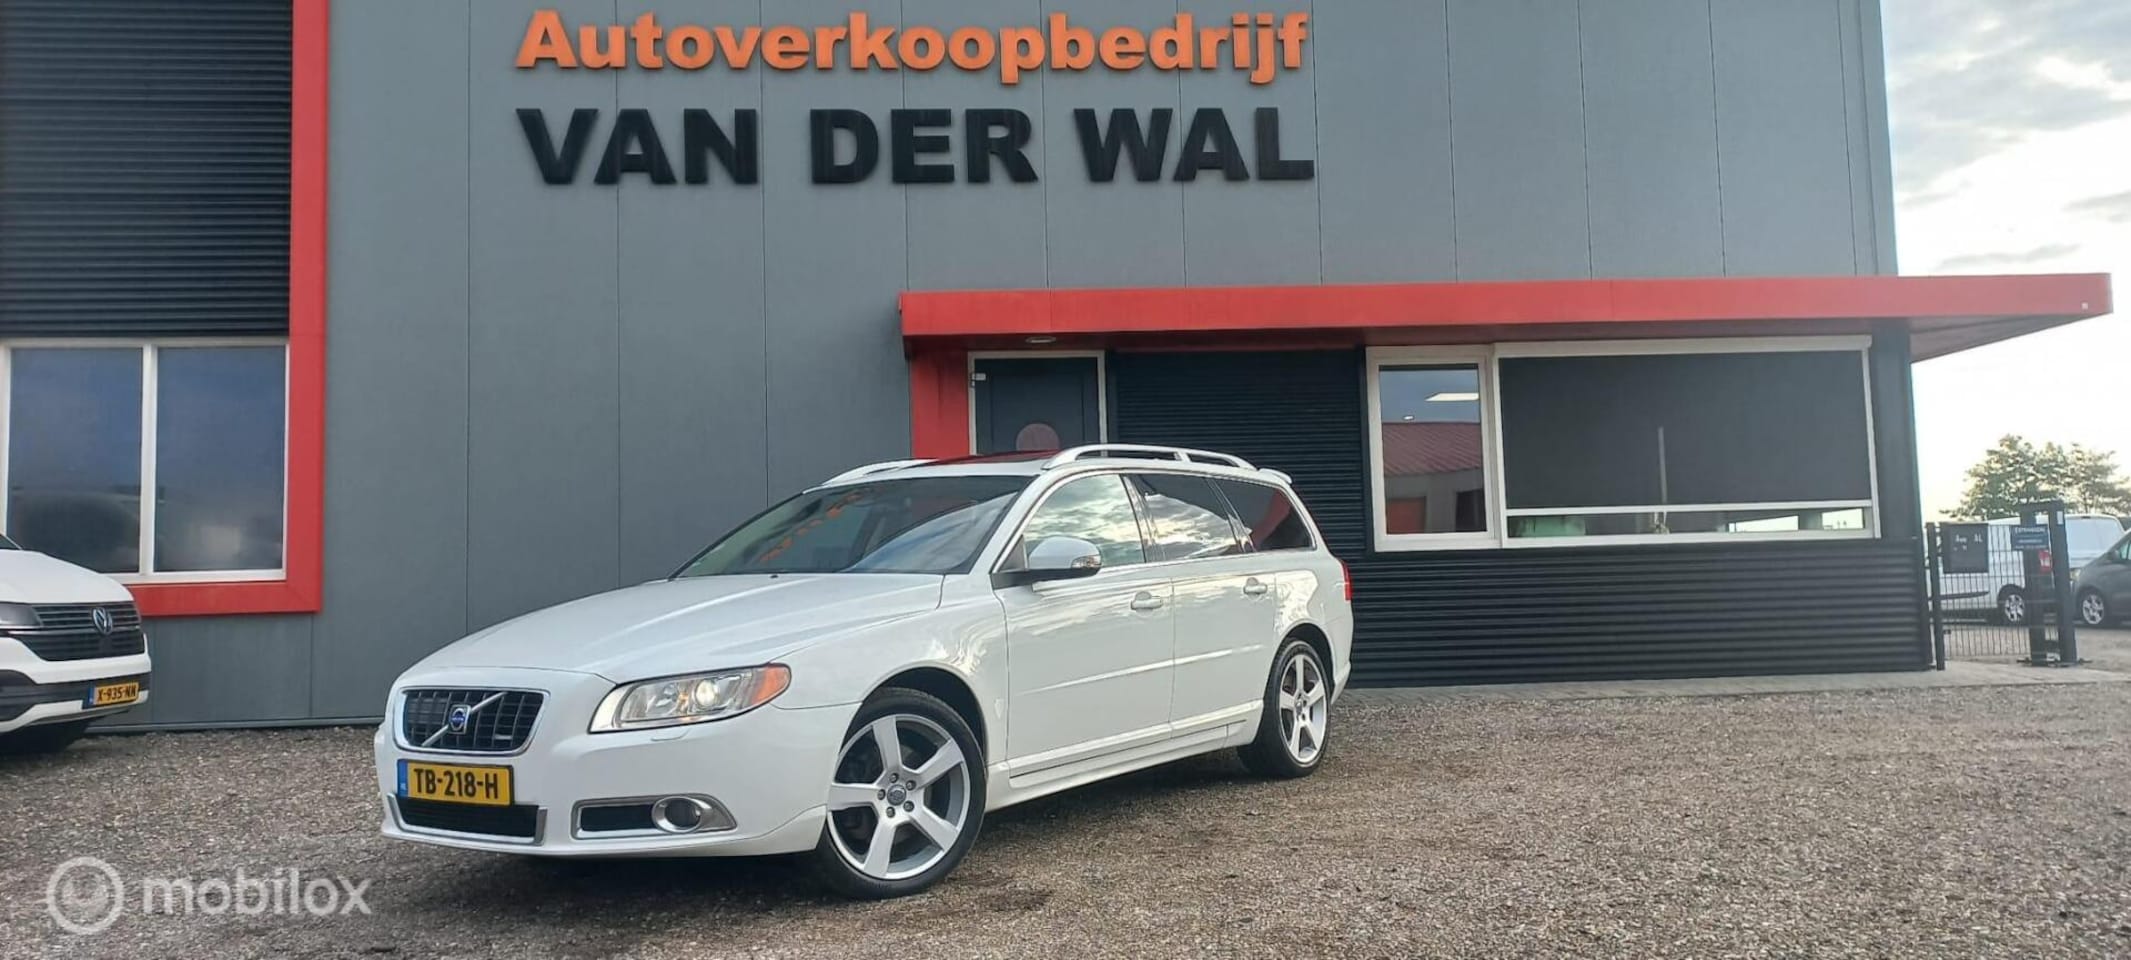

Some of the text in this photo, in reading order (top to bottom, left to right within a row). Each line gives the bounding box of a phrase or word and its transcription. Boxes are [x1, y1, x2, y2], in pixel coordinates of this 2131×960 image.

[515, 10, 1307, 84] Autoverkoopbedrijf
[516, 106, 1315, 185] VAN DER WAL
[413, 768, 499, 800] TB-218-H
